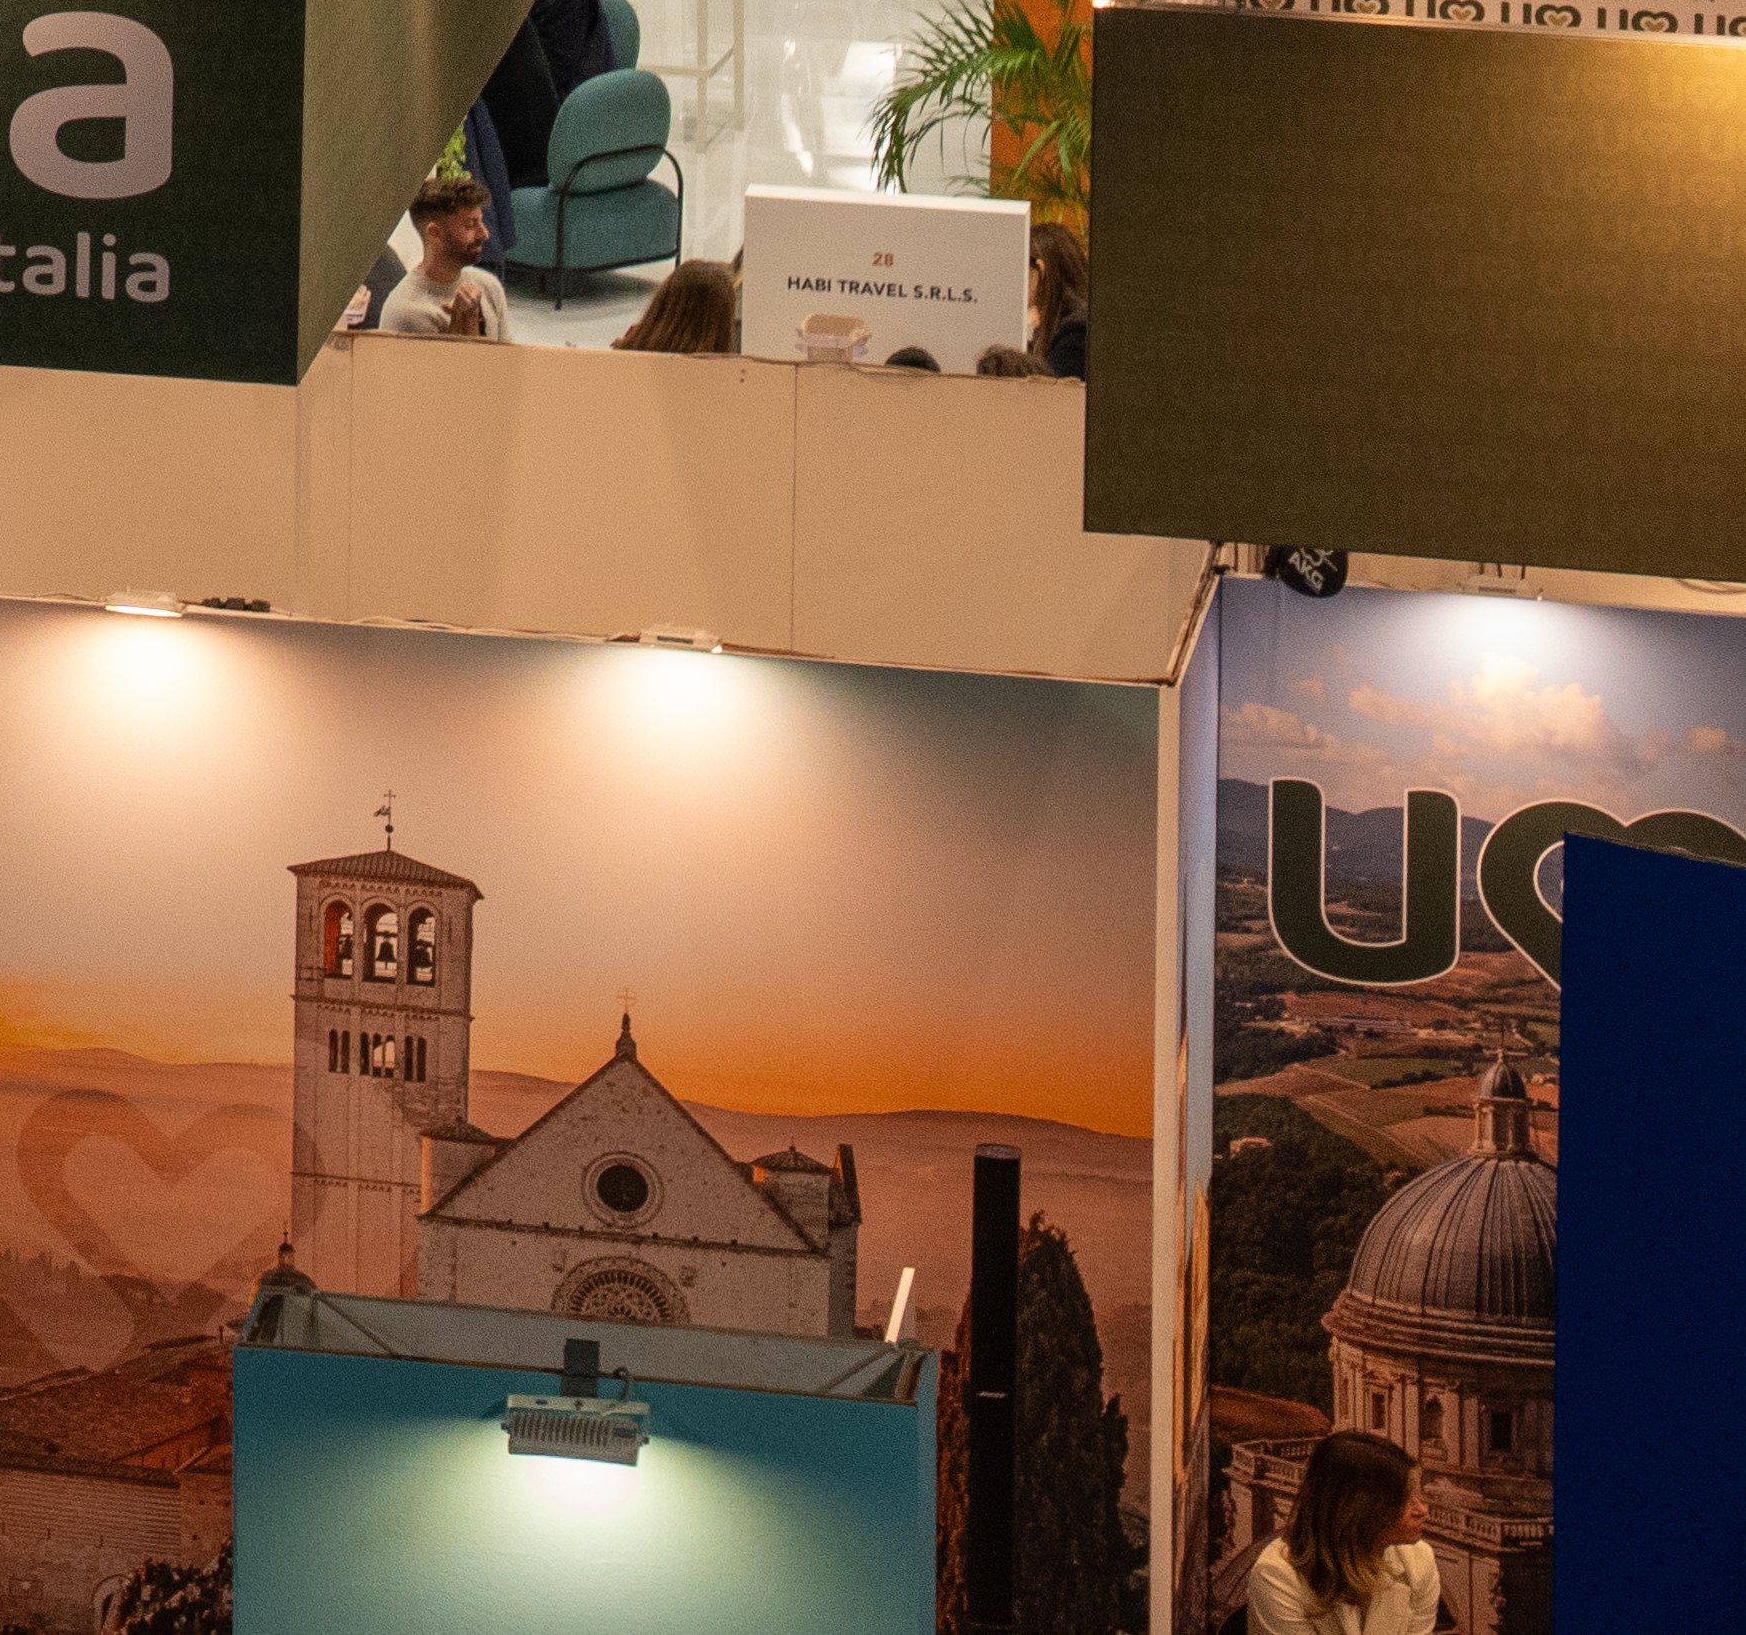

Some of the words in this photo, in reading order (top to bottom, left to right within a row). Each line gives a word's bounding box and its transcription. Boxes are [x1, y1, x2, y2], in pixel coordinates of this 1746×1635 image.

[872, 251, 894, 267] 28
[787, 276, 832, 292] HABI
[837, 278, 908, 298] TRAVEL
[913, 284, 979, 304] S.R.L.S.
